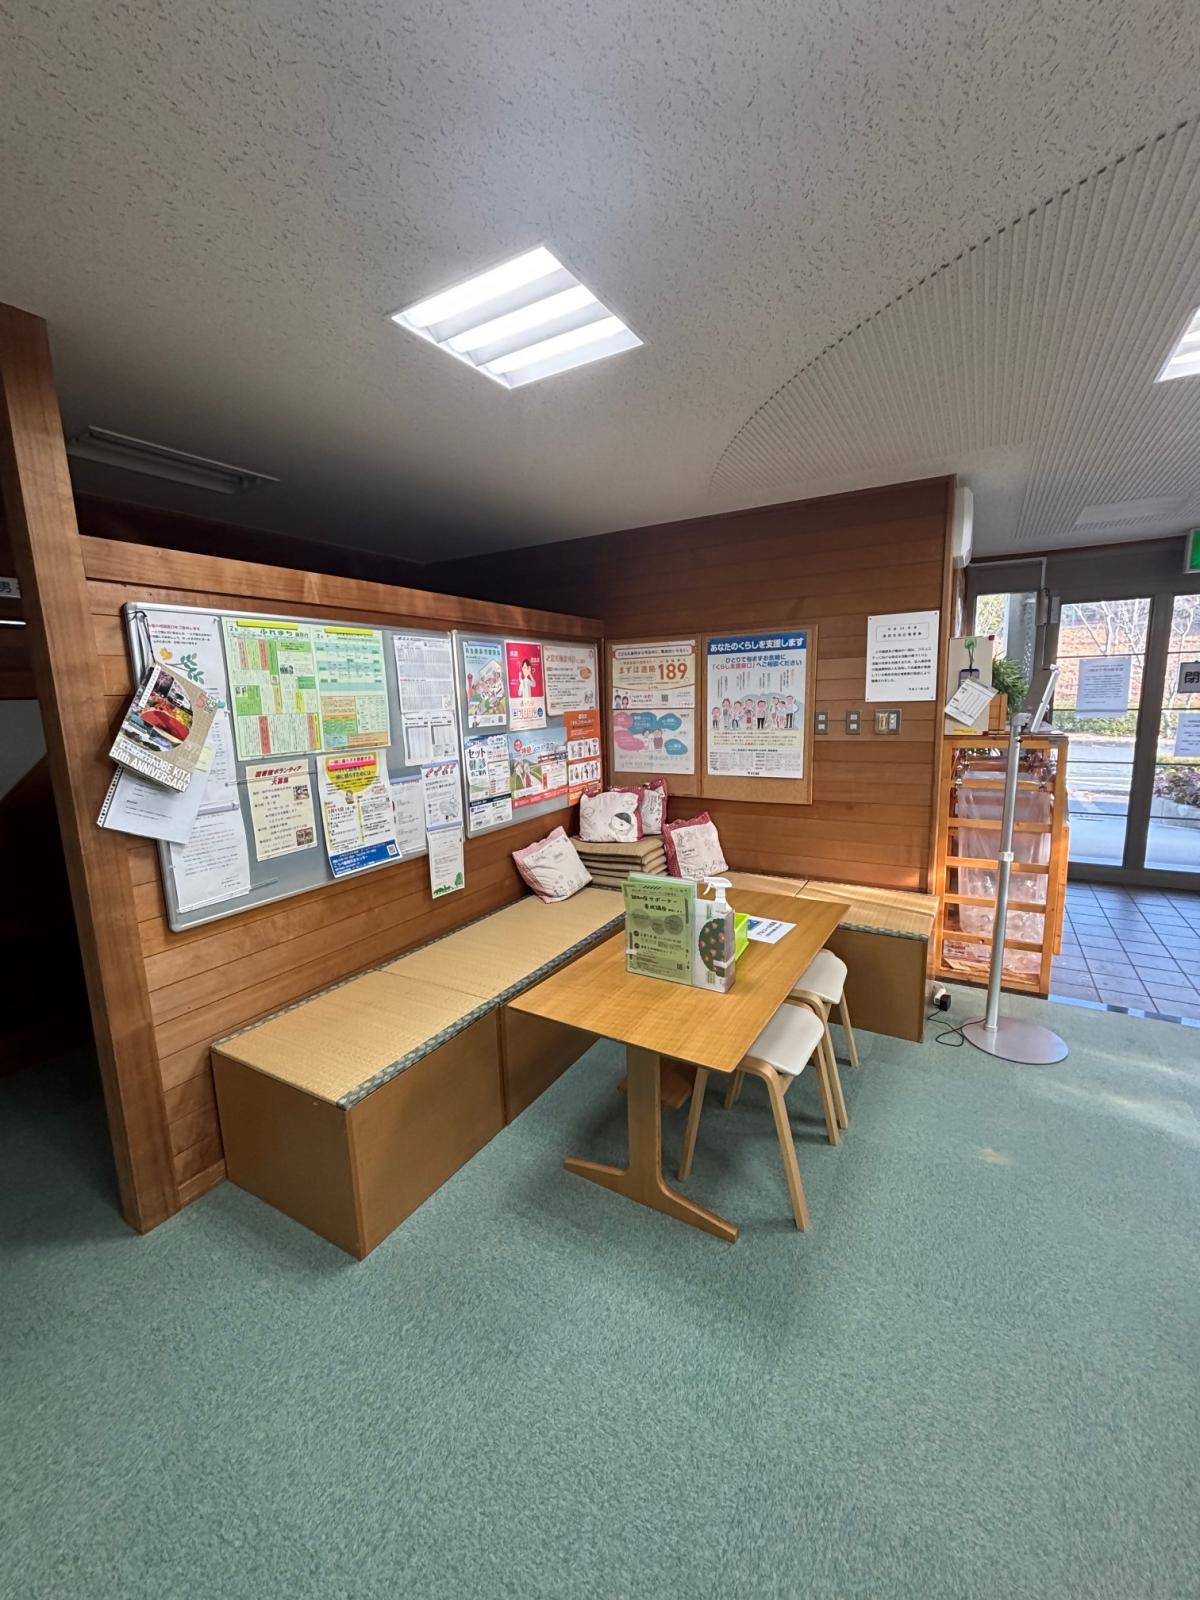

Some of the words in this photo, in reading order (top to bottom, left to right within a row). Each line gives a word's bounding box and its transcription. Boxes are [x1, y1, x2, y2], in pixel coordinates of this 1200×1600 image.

[710, 637, 804, 652] あなたのくらしを支援します
[725, 654, 786, 664] ひとりで悩まずお気軽に
[658, 662, 688, 681] 189
[469, 748, 486, 759] セット
[132, 757, 190, 793] ANNIVERSARY
